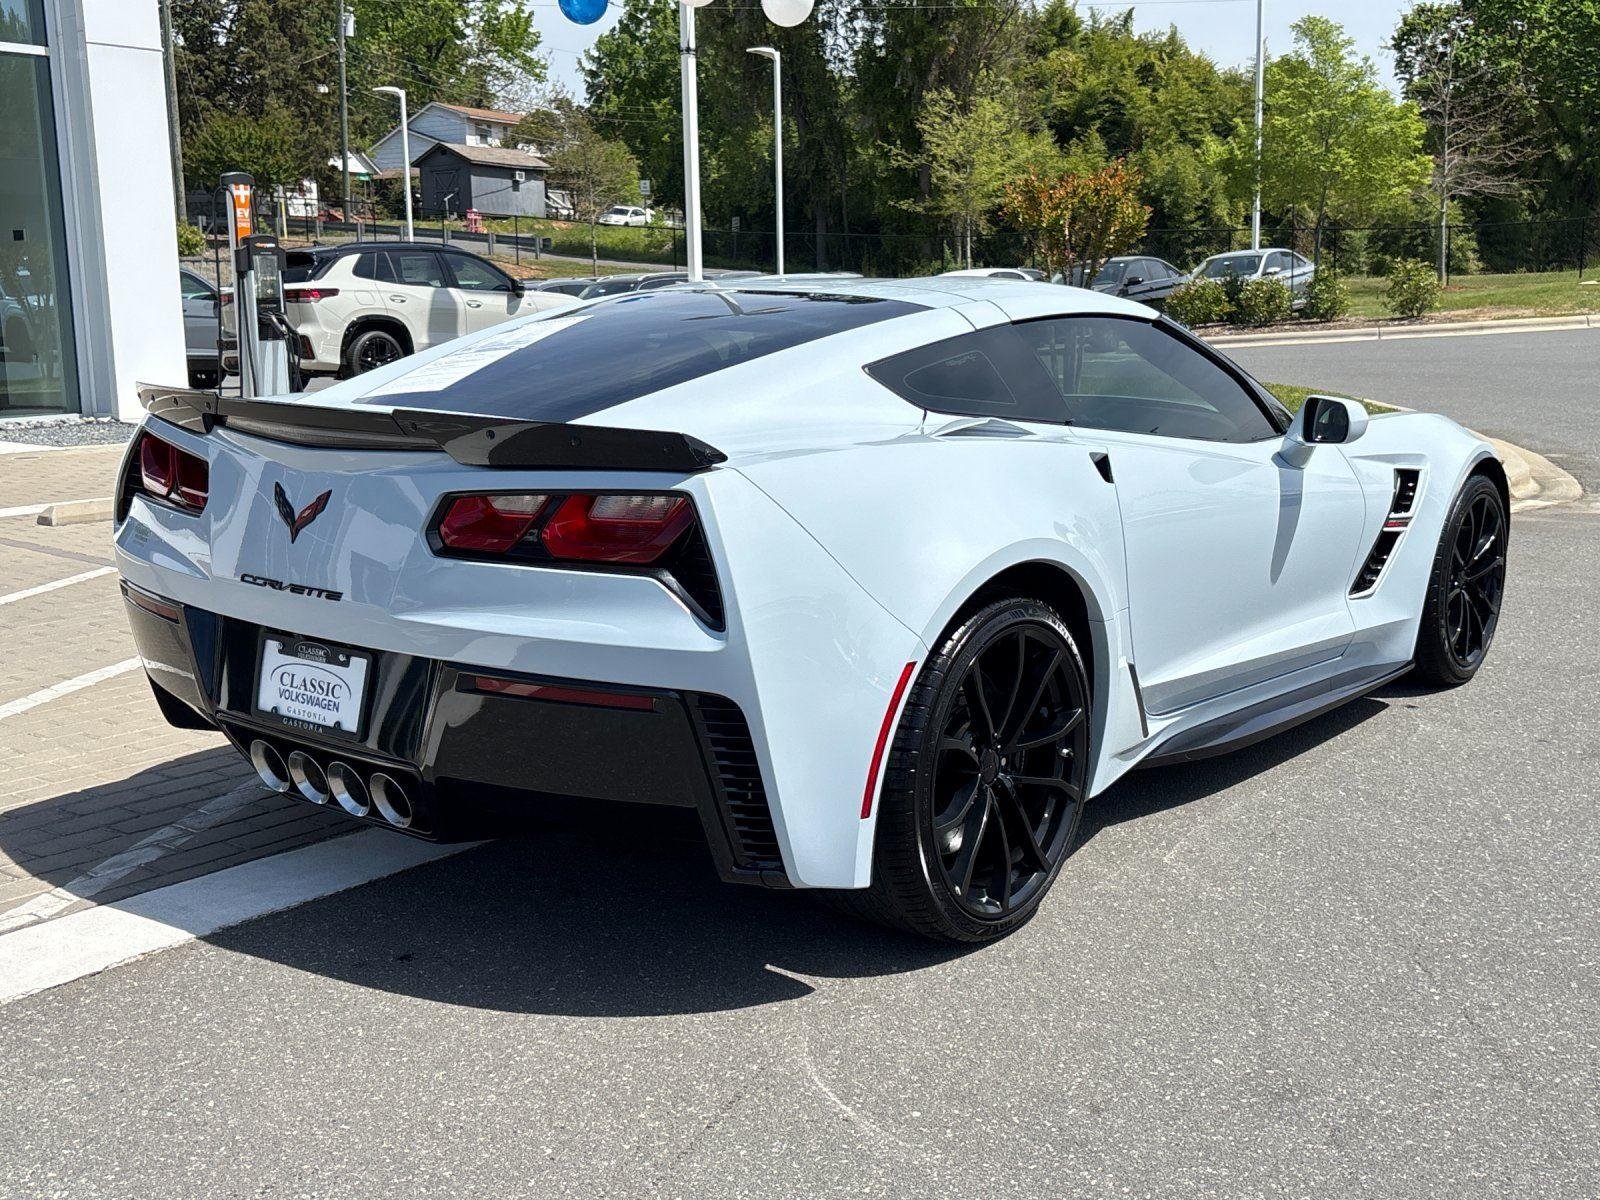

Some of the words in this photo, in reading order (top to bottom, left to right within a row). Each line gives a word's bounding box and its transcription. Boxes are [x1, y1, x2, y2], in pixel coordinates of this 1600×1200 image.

[237, 209, 250, 218] EV
[240, 573, 343, 602] CORVETTE
[298, 645, 327, 657] CLASSIC
[280, 671, 342, 699] CLASSIC
[278, 687, 340, 713] VOLKSWAGEN
[286, 705, 327, 722] GASTONIA
[282, 717, 323, 733] GASTONIA
